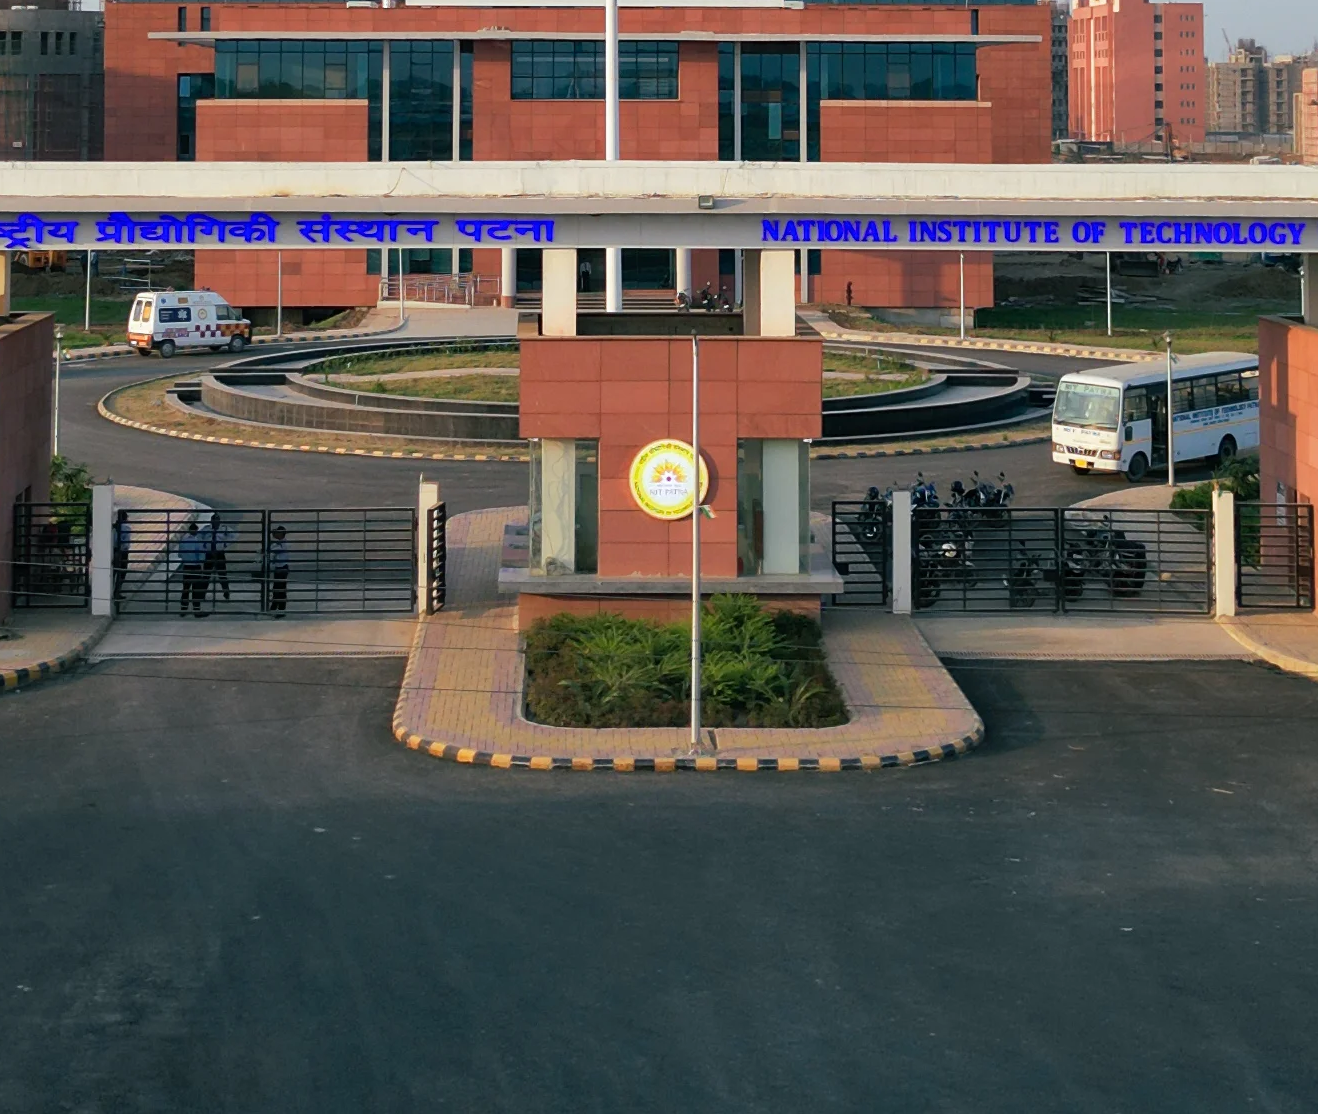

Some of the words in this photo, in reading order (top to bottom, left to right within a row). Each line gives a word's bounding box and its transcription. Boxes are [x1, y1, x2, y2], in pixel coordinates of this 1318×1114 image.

[94, 211, 281, 245] प्रौद्योगिकी
[296, 212, 440, 244] संस्थान
[455, 218, 556, 243] पटना
[761, 218, 899, 243] NATIONAL
[907, 218, 1061, 244] INSTITUTE
[1070, 219, 1108, 245] OF
[1119, 220, 1307, 246] TECHNOLOGY
